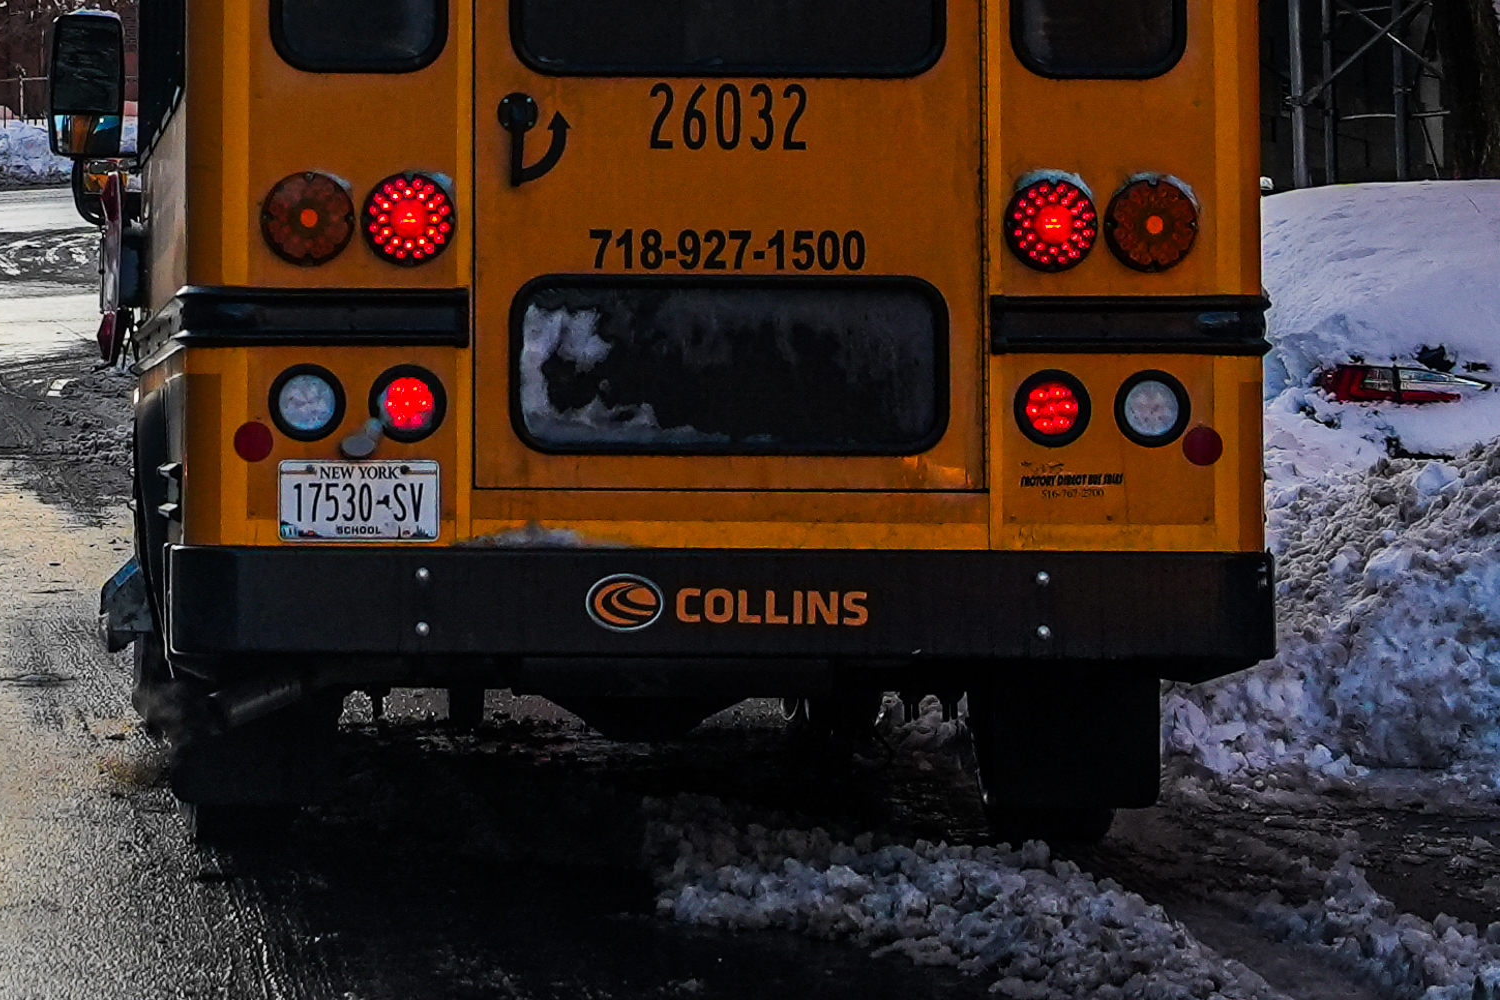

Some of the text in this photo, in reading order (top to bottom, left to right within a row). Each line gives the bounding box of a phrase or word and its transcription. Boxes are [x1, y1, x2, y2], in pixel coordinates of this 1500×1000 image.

[649, 82, 808, 151] 26032
[589, 228, 866, 270] 718-927-1500
[320, 466, 400, 480] NEW YORK
[1088, 474, 1102, 485] BUS
[336, 525, 381, 535] SCHOOL
[675, 587, 869, 627] COLLINS
